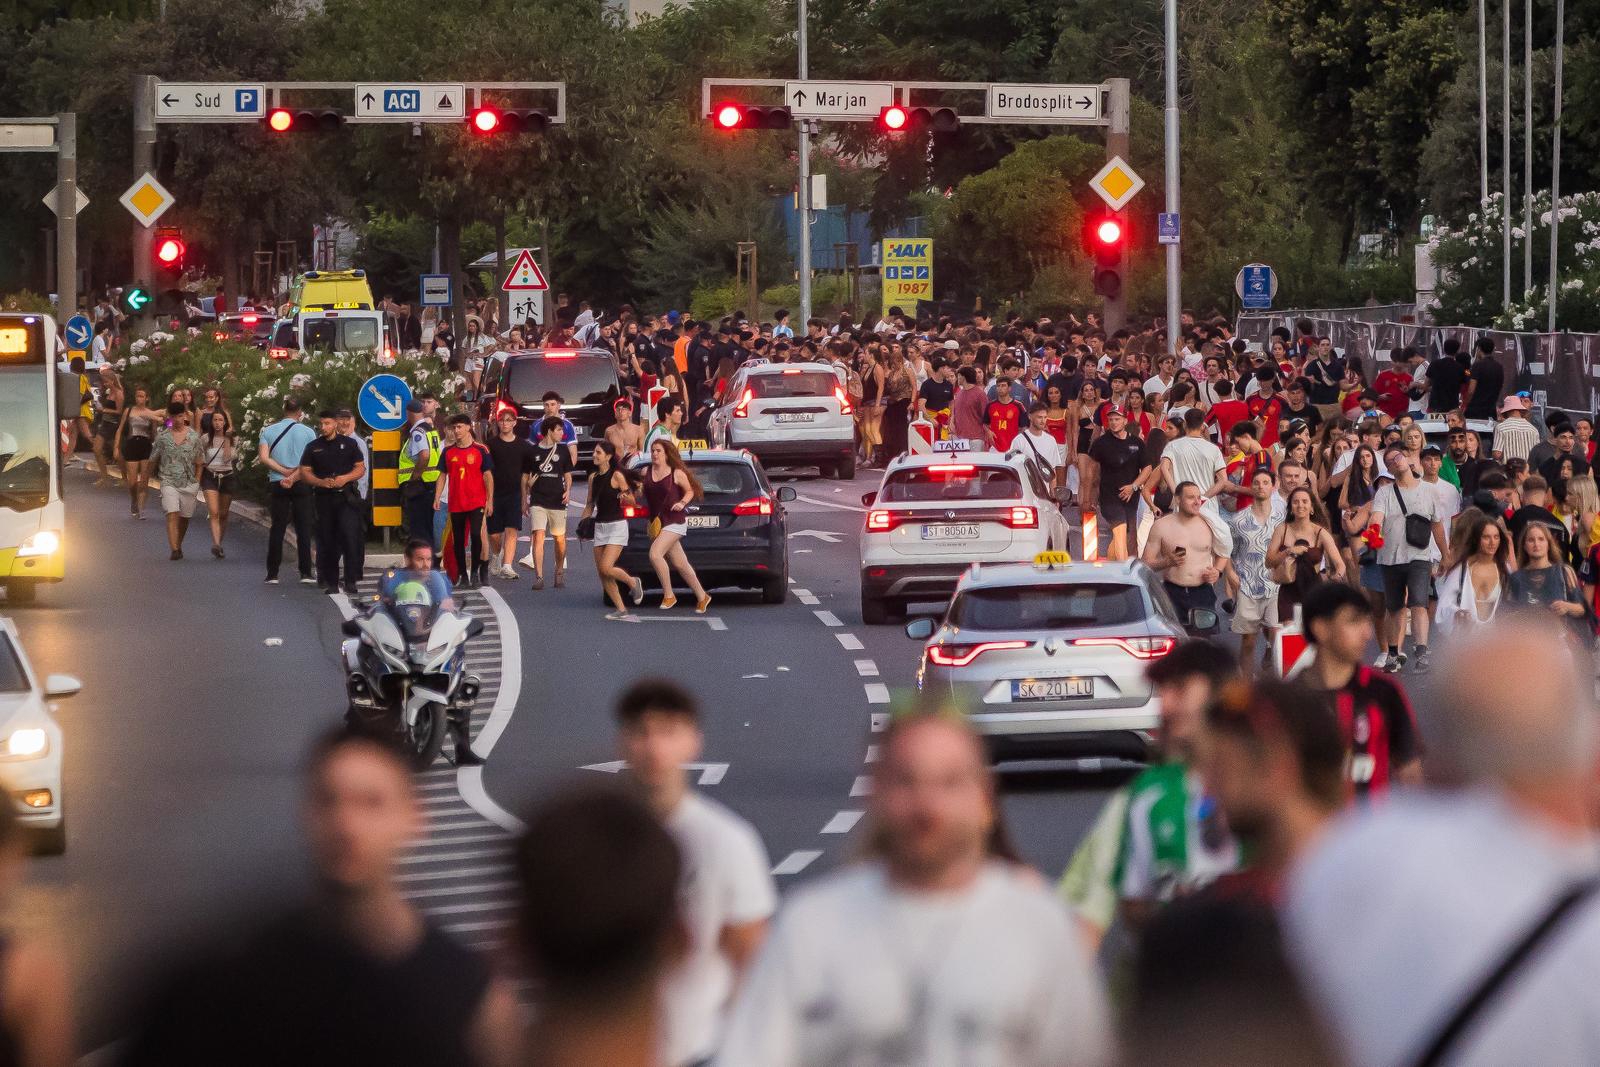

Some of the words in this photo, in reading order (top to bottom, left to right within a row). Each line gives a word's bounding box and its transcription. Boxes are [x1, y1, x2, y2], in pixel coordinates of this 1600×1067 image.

[195, 92, 220, 107] Sud
[240, 92, 253, 109] P
[387, 92, 417, 110] ACI
[816, 91, 866, 110] Marjan
[998, 93, 1072, 112] Brodosplit
[888, 243, 928, 258] HAK
[898, 282, 928, 294] 1987
[998, 419, 1007, 430] 14
[682, 441, 703, 449] TAXI
[939, 442, 965, 450] TAXI
[458, 467, 466, 480] 7
[928, 527, 938, 537] ST
[944, 526, 966, 536] 8050
[1038, 554, 1065, 564] TAXI
[1020, 683, 1036, 697] SK
[1046, 680, 1092, 696] 201-LU
